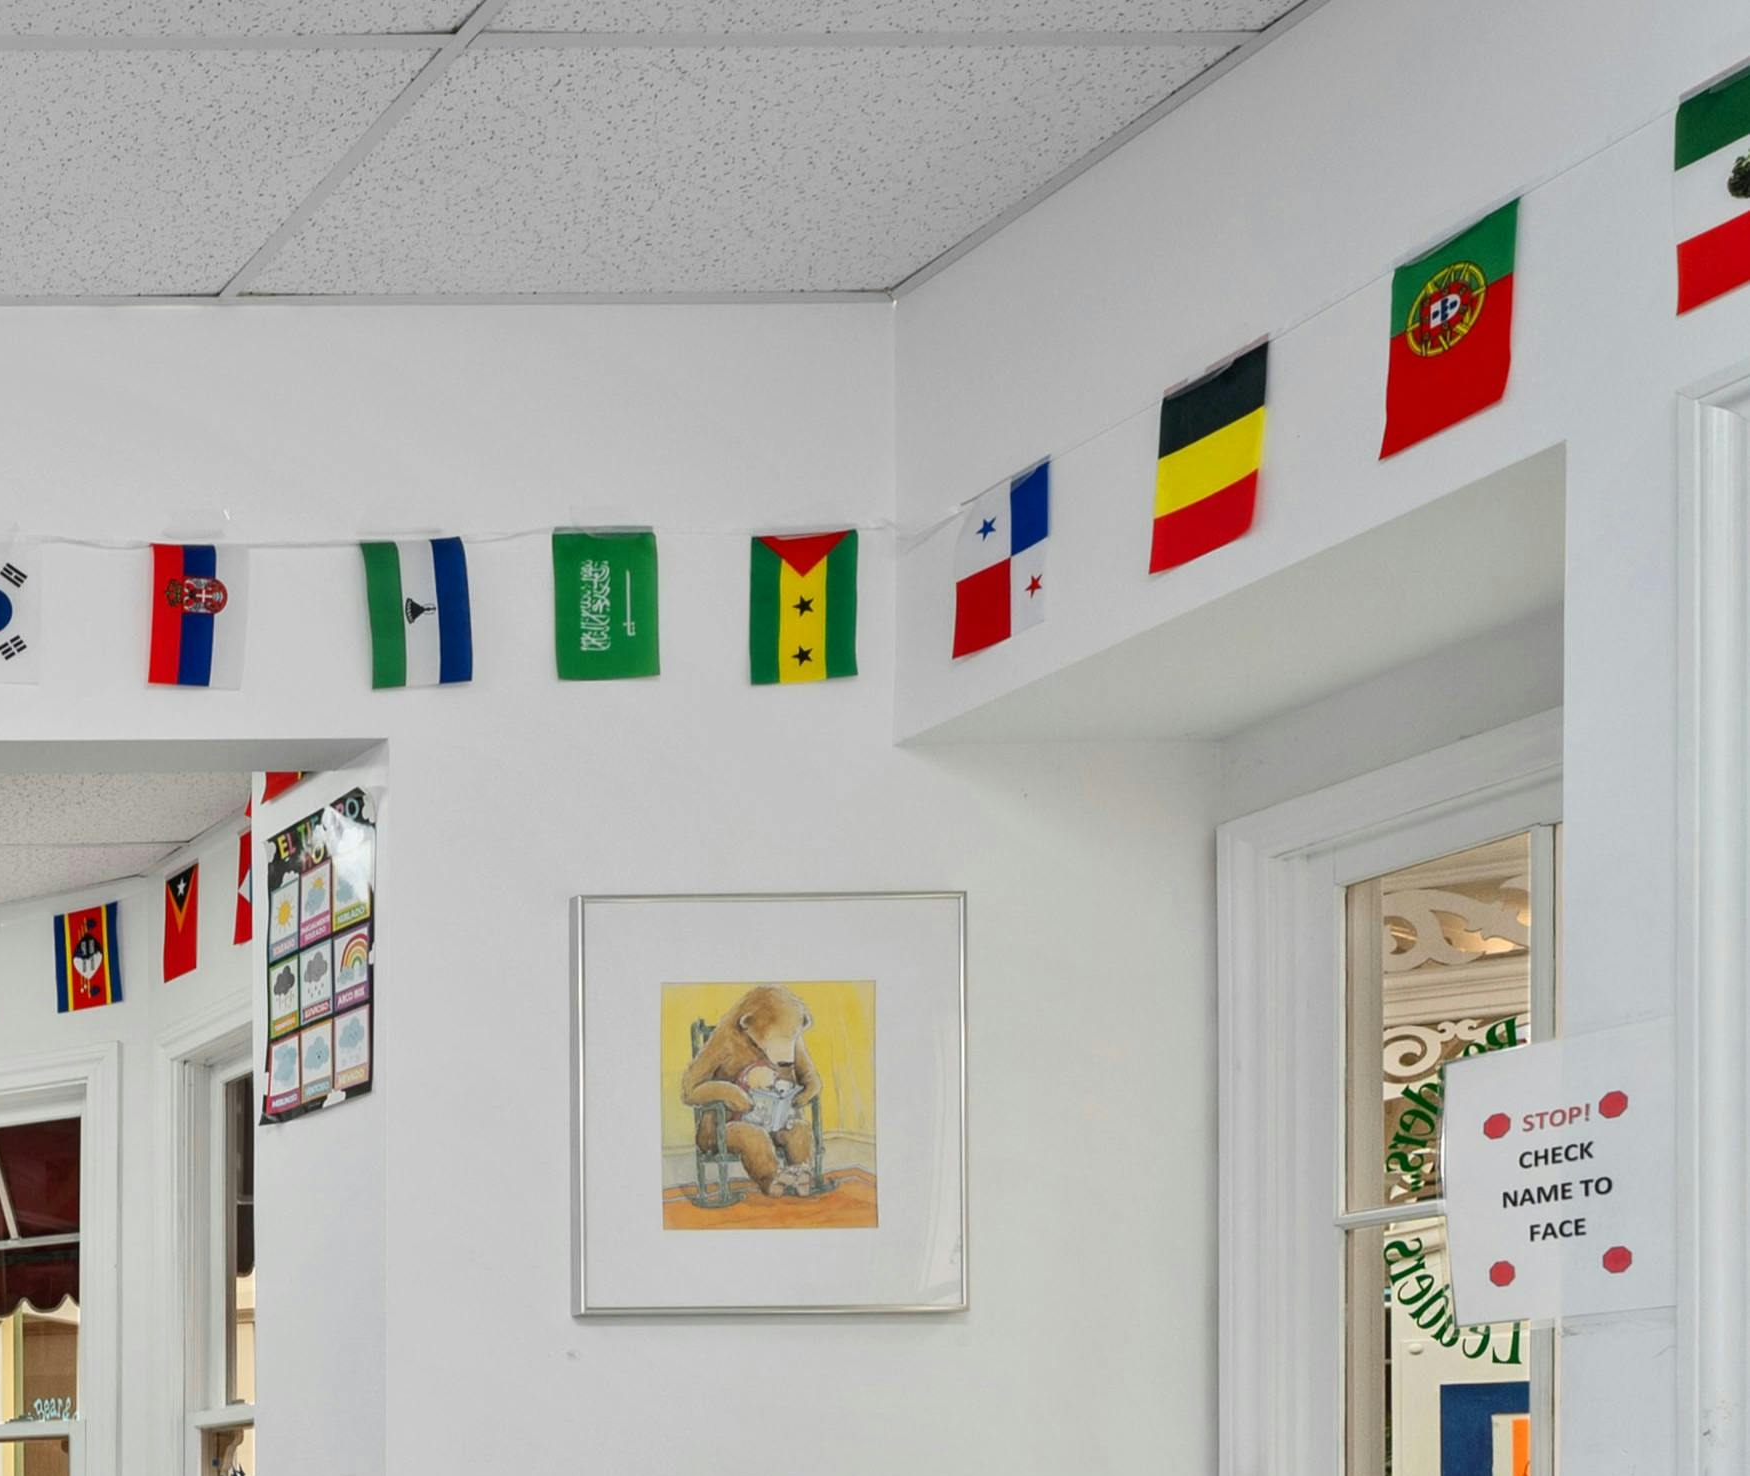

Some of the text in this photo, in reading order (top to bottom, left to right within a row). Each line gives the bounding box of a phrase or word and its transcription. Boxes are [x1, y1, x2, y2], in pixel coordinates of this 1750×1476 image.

[1522, 1102, 1591, 1133] STOP!
[1518, 1141, 1594, 1169] CHECK
[1502, 1176, 1614, 1209] NAME TO
[1529, 1218, 1587, 1242] FACE
